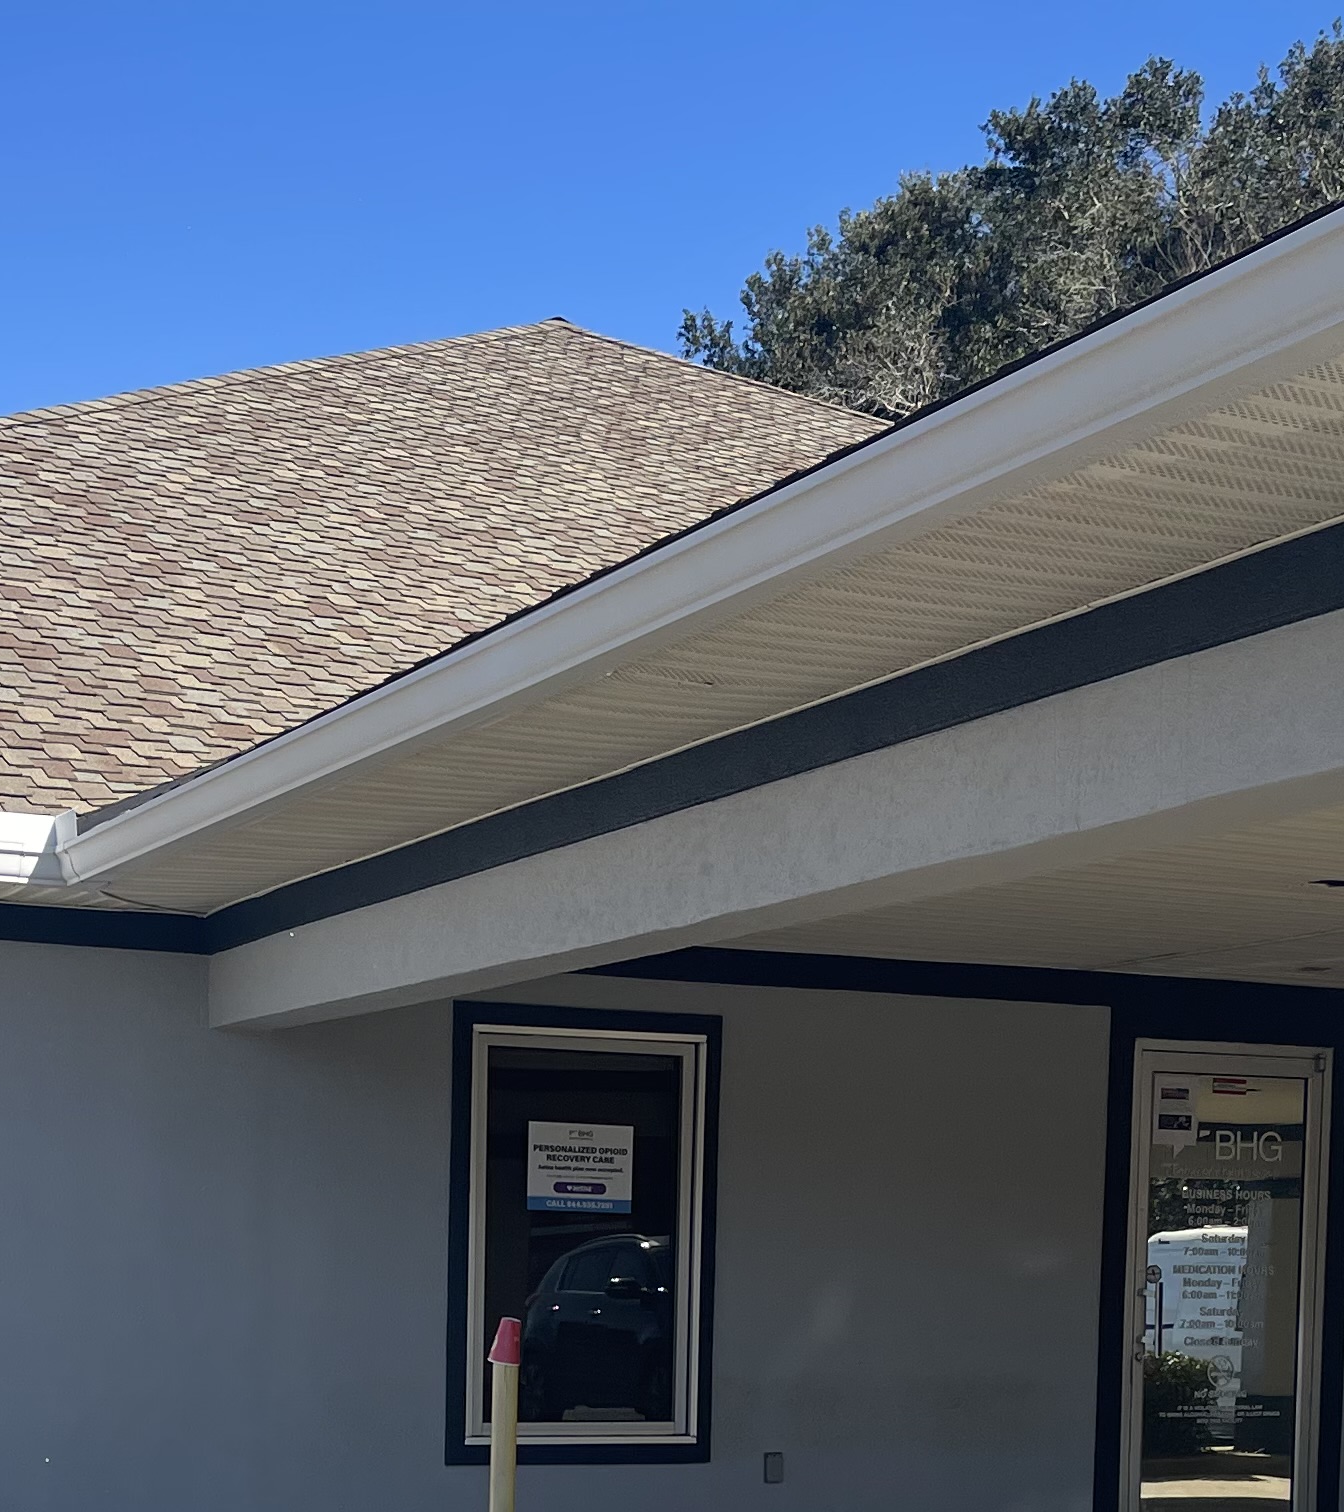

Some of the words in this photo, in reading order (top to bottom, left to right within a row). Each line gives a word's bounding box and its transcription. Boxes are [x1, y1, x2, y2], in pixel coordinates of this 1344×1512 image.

[533, 1144, 597, 1154] PERSONALIZED
[598, 1147, 628, 1156] OPIOID
[1215, 1129, 1283, 1162] BHG
[546, 1154, 591, 1163] RECOVERY
[592, 1155, 615, 1164] CARE
[1182, 1188, 1234, 1201] BUSINESS
[1235, 1189, 1271, 1201] HOURS
[545, 1199, 566, 1208] CALL
[1186, 1203, 1226, 1217] Monday
[1201, 1233, 1246, 1245] Saturday
[1183, 1246, 1219, 1257] 7:00am
[1227, 1247, 1266, 1258] 10:0am
[1172, 1264, 1236, 1275] MEDICATION
[1238, 1264, 1275, 1276] HOURS
[1182, 1277, 1223, 1290] Monday
[1182, 1290, 1218, 1300] 6:00am
[1199, 1306, 1243, 1318] Saturday
[1179, 1318, 1216, 1329] 7:00am
